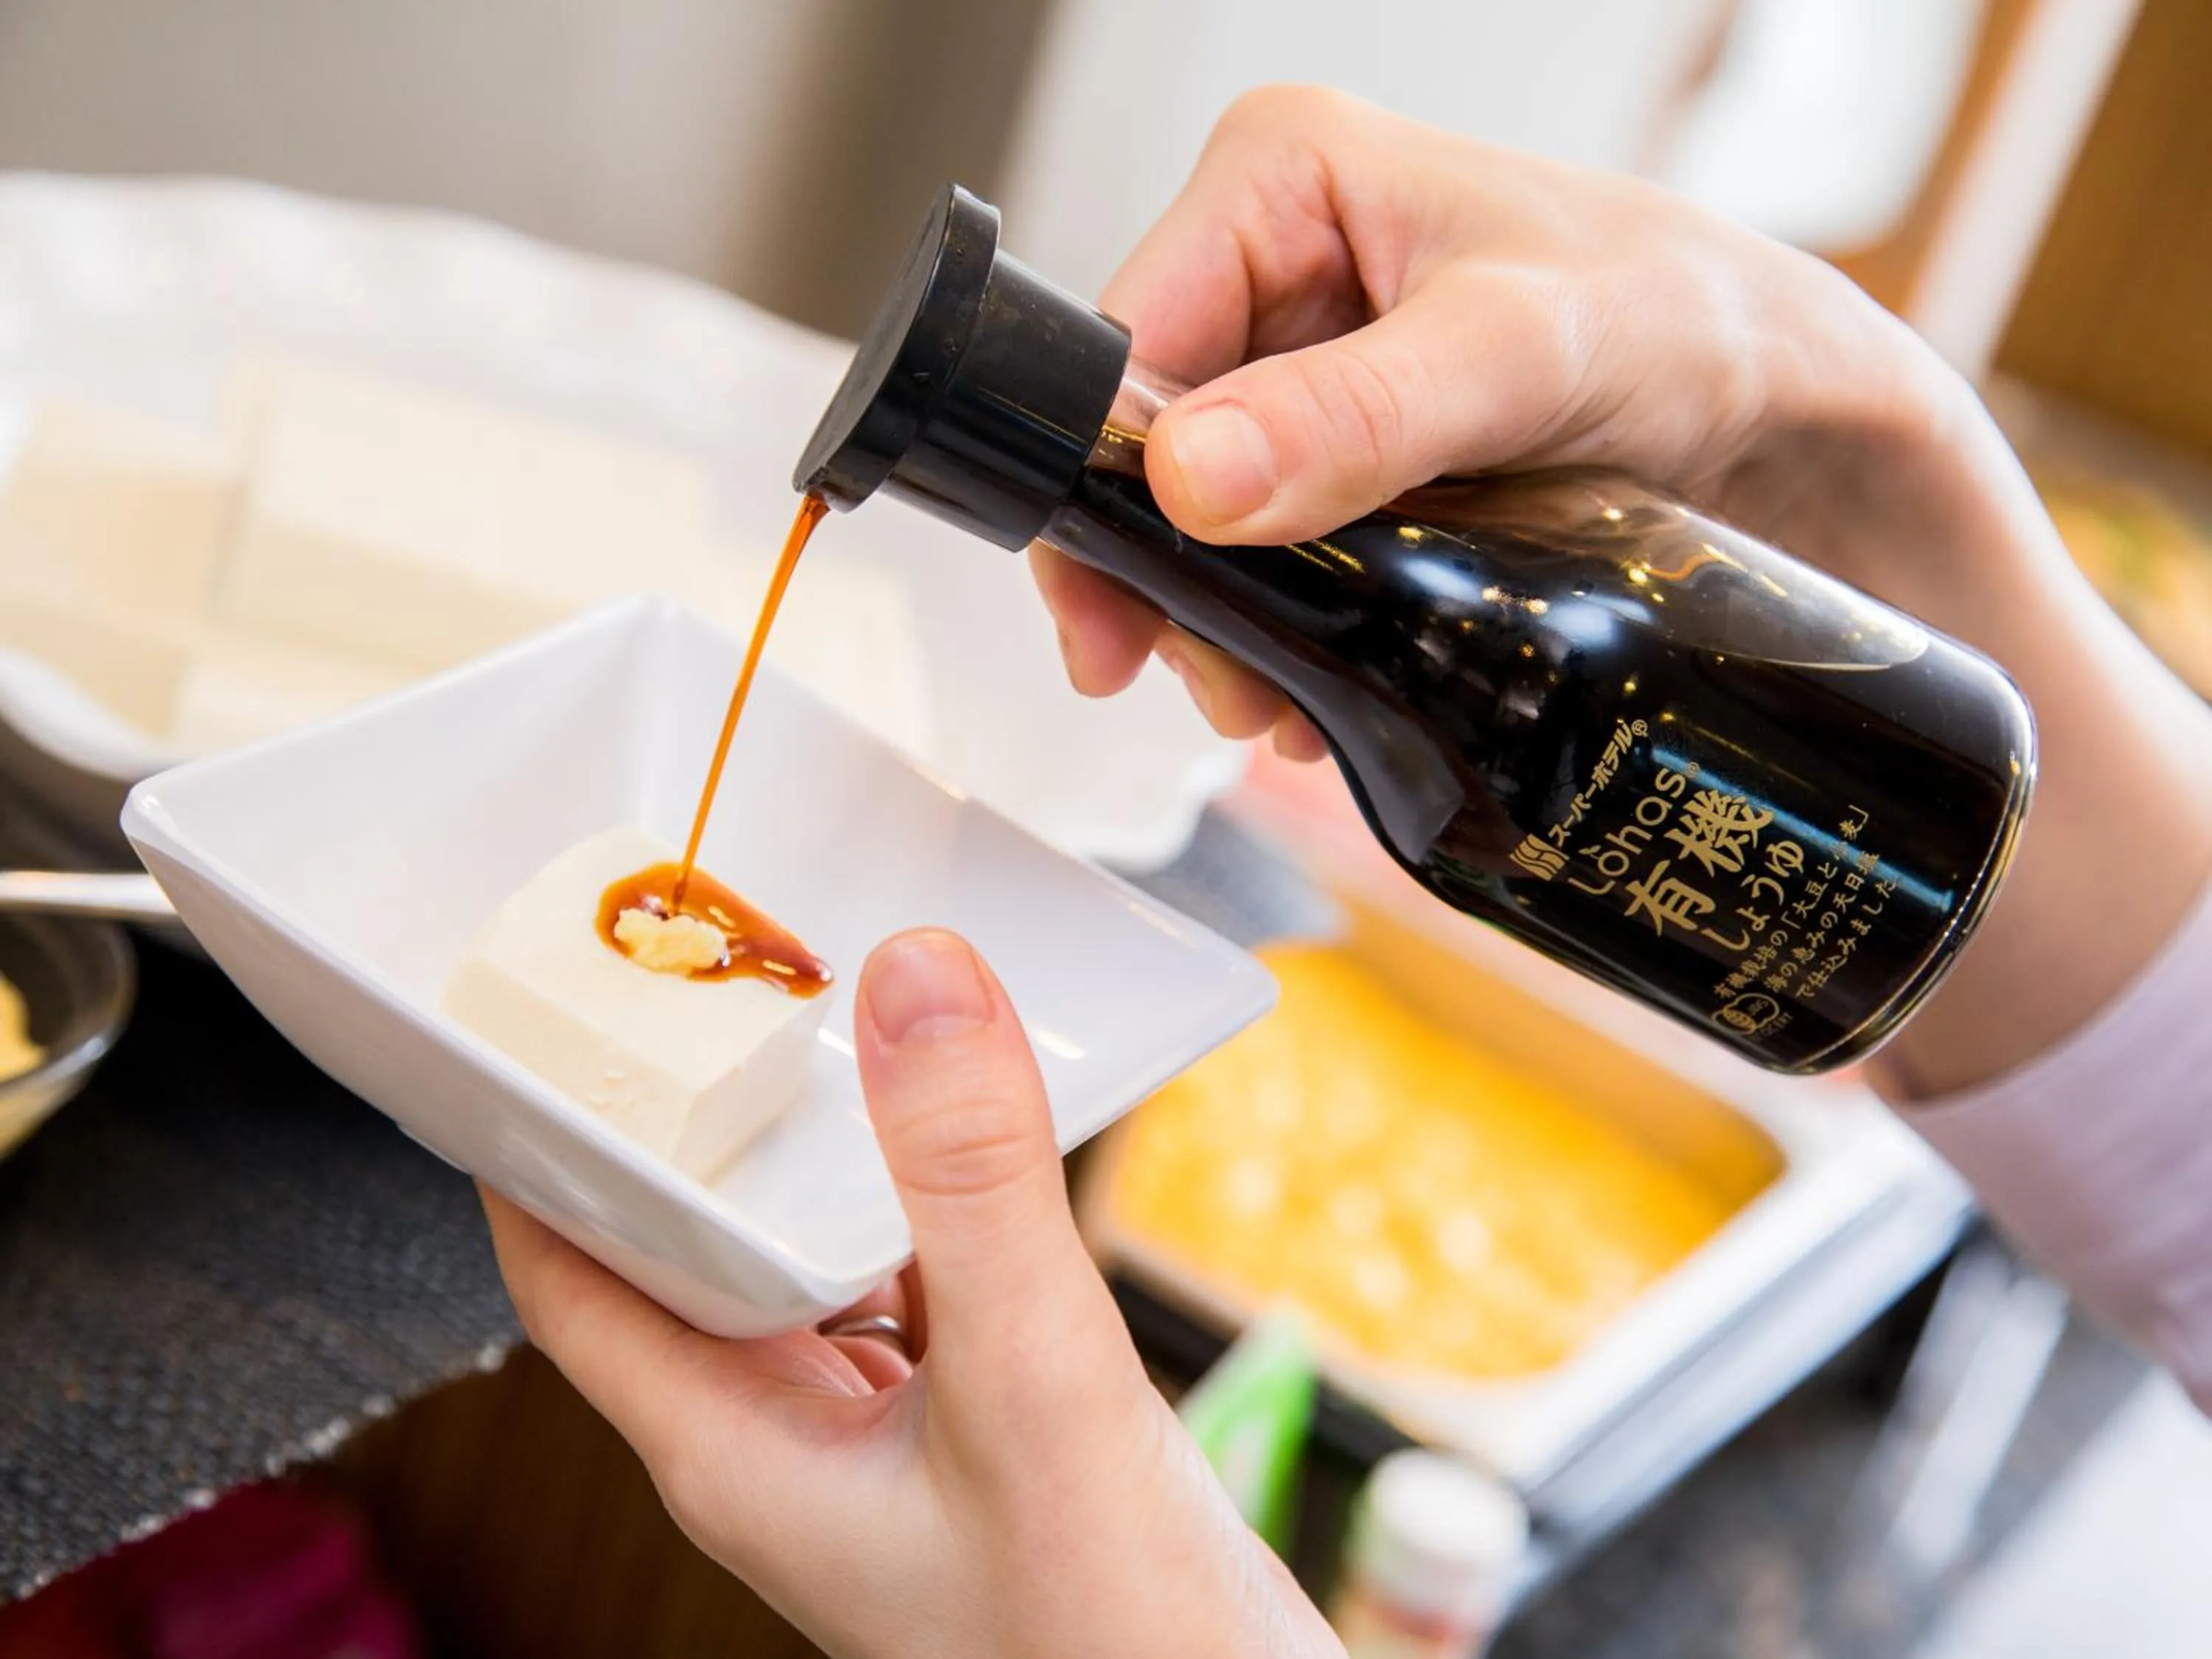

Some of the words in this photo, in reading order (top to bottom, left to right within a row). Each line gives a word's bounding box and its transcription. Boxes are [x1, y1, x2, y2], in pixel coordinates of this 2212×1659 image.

[1548, 718, 1632, 848] スーパーホテル
[1624, 789, 1775, 937] 有機
[1701, 840, 1804, 951] しょうゆ
